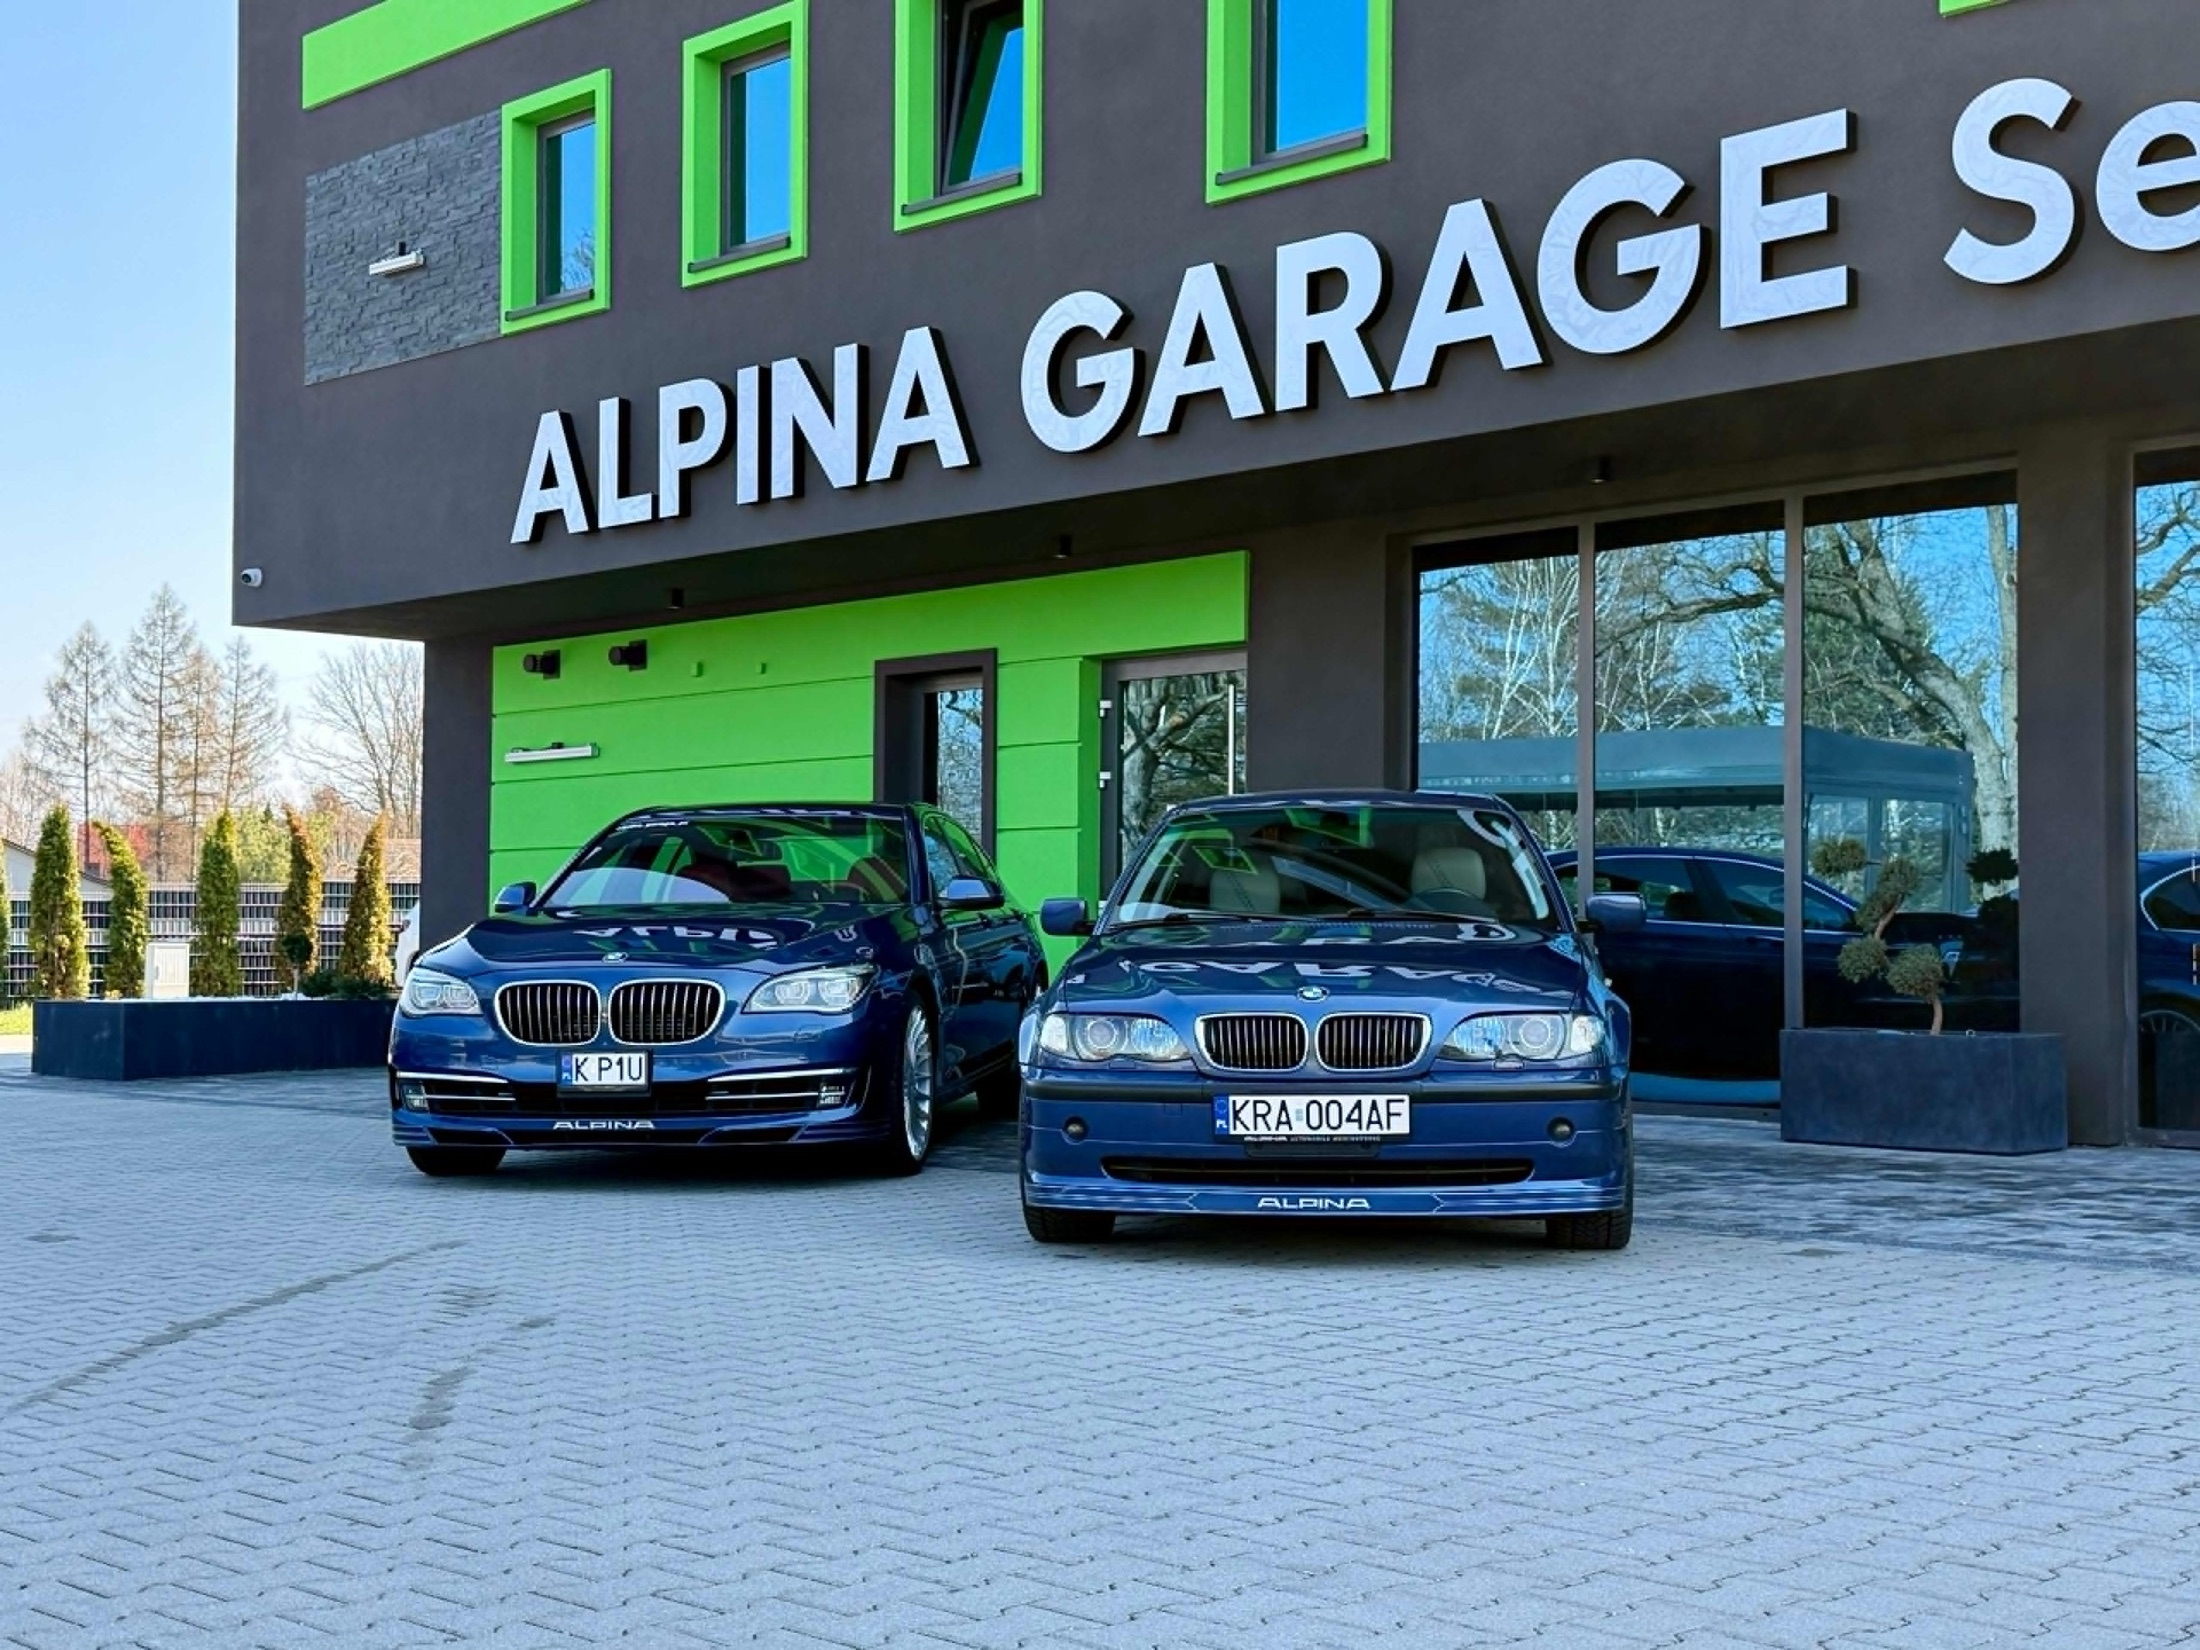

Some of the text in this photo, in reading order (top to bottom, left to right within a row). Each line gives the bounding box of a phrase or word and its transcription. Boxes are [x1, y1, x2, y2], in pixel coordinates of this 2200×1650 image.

[511, 77, 2200, 544] ALPINA GARAGE Se
[575, 1056, 643, 1082] K P1U
[553, 1120, 656, 1130] ALPINA
[1231, 1099, 1406, 1131] KRA 004AF
[1257, 1197, 1371, 1210] ALPINA
